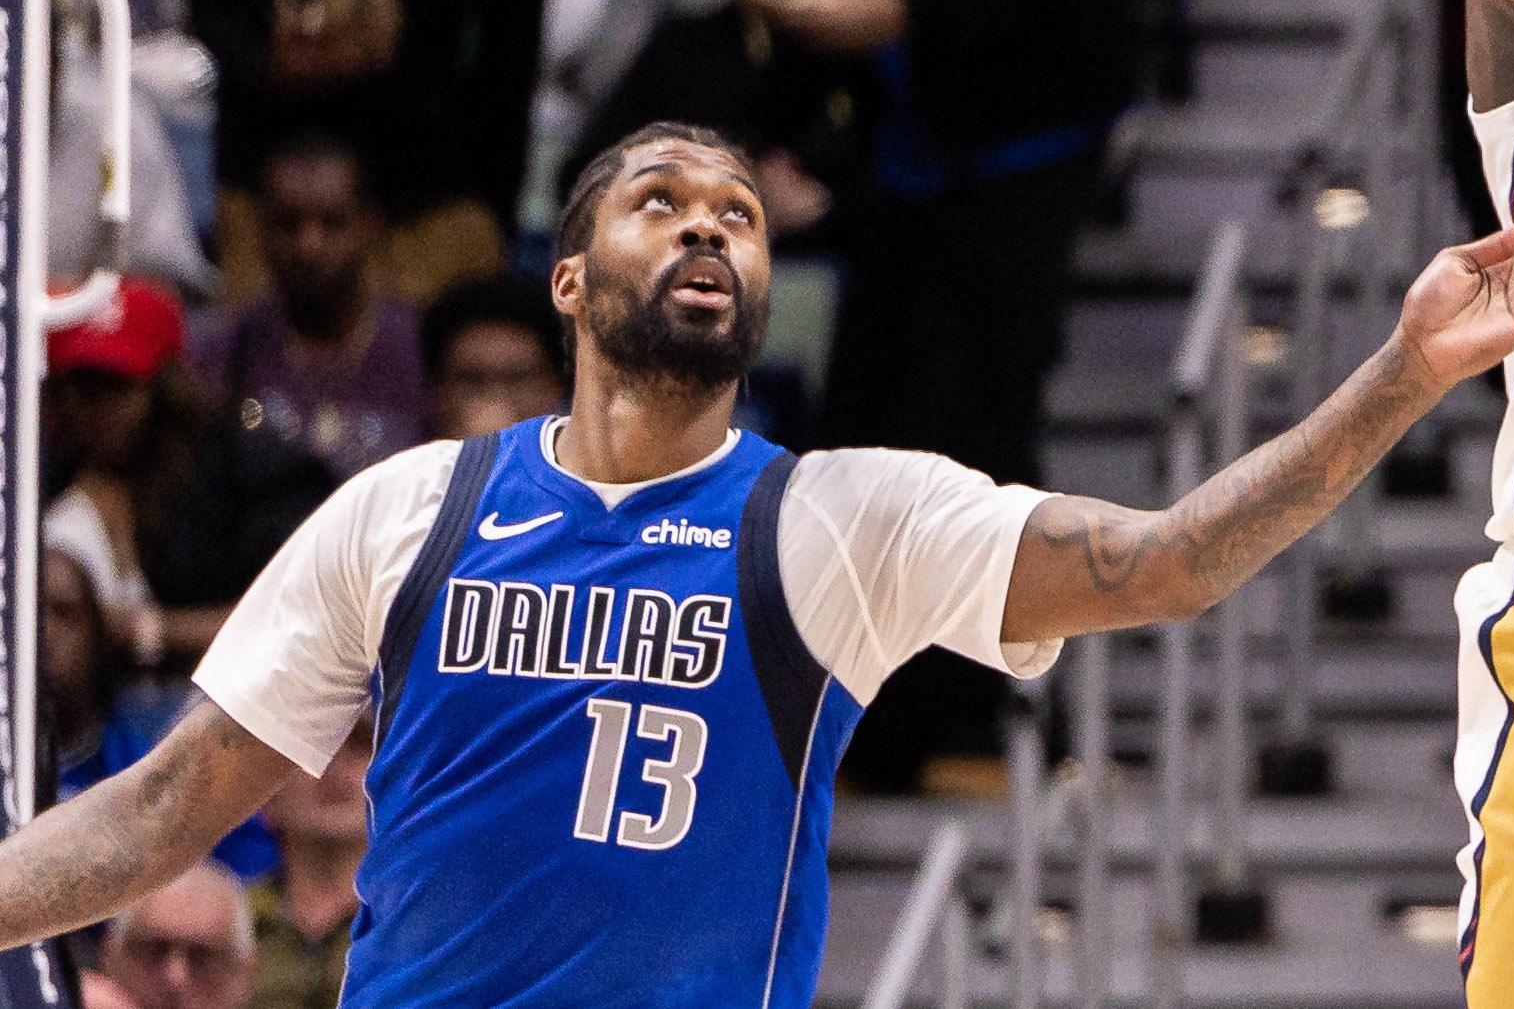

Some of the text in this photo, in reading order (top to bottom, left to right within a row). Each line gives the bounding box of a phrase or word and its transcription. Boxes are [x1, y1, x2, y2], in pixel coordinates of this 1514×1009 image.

[641, 518, 731, 548] chime
[438, 577, 732, 689] DALLAS
[573, 698, 708, 850] 13
